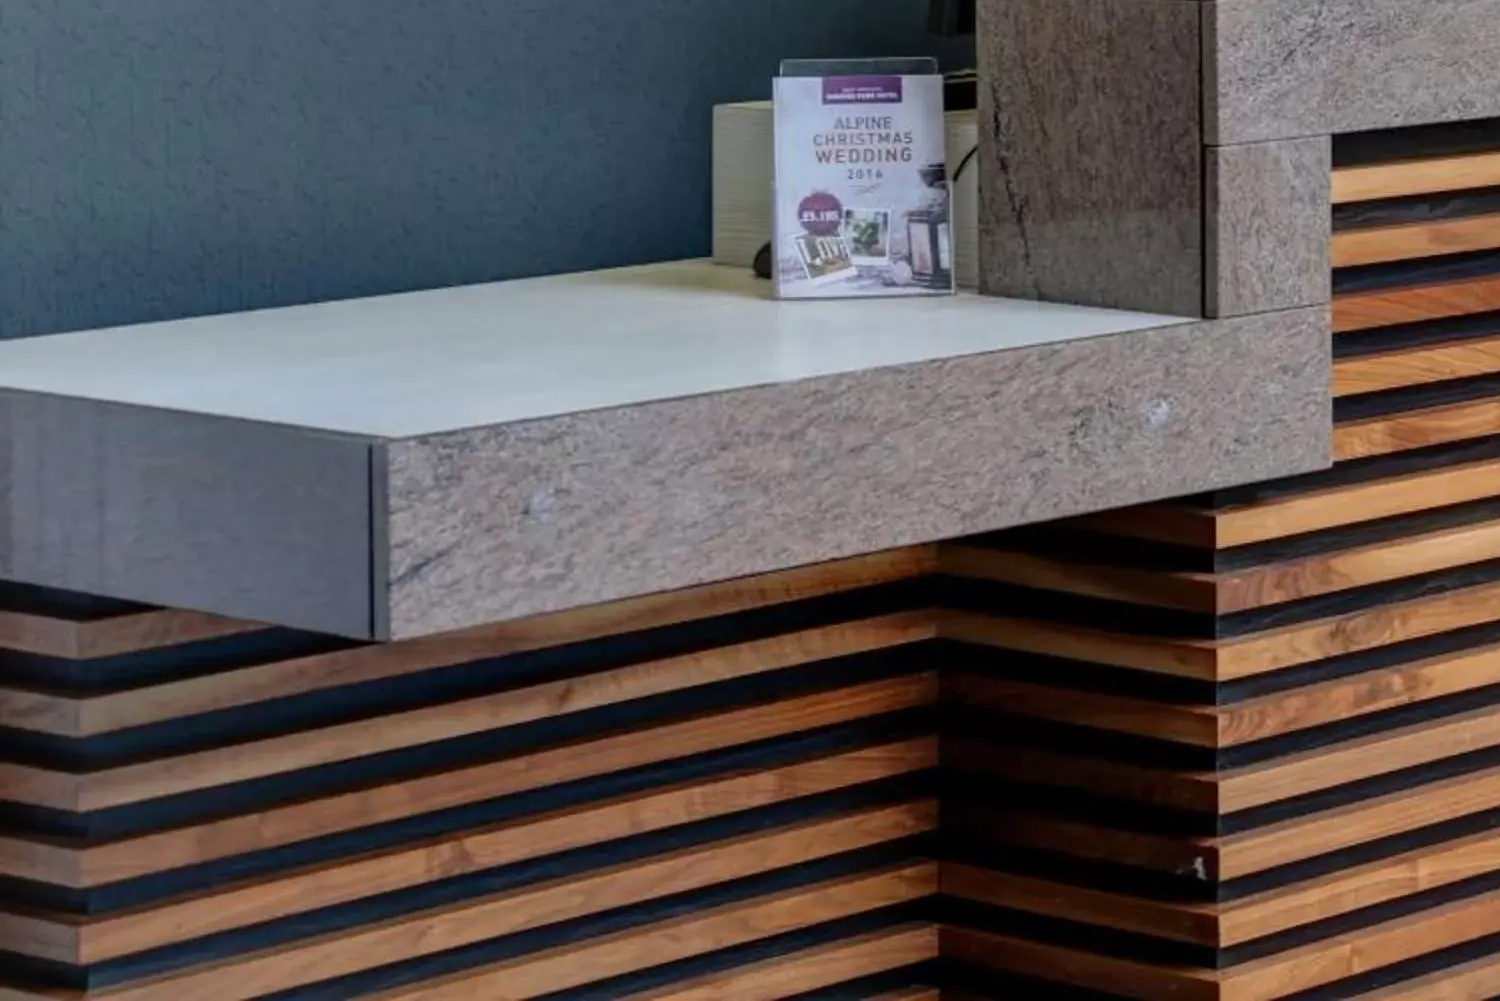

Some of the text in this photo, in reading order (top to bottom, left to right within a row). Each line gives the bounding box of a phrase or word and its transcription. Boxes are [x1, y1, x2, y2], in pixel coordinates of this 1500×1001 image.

[833, 116, 893, 130] ALPINE
[812, 131, 913, 147] CHRISTMAS
[815, 146, 913, 164] WEDDING
[846, 168, 884, 180] 2016
